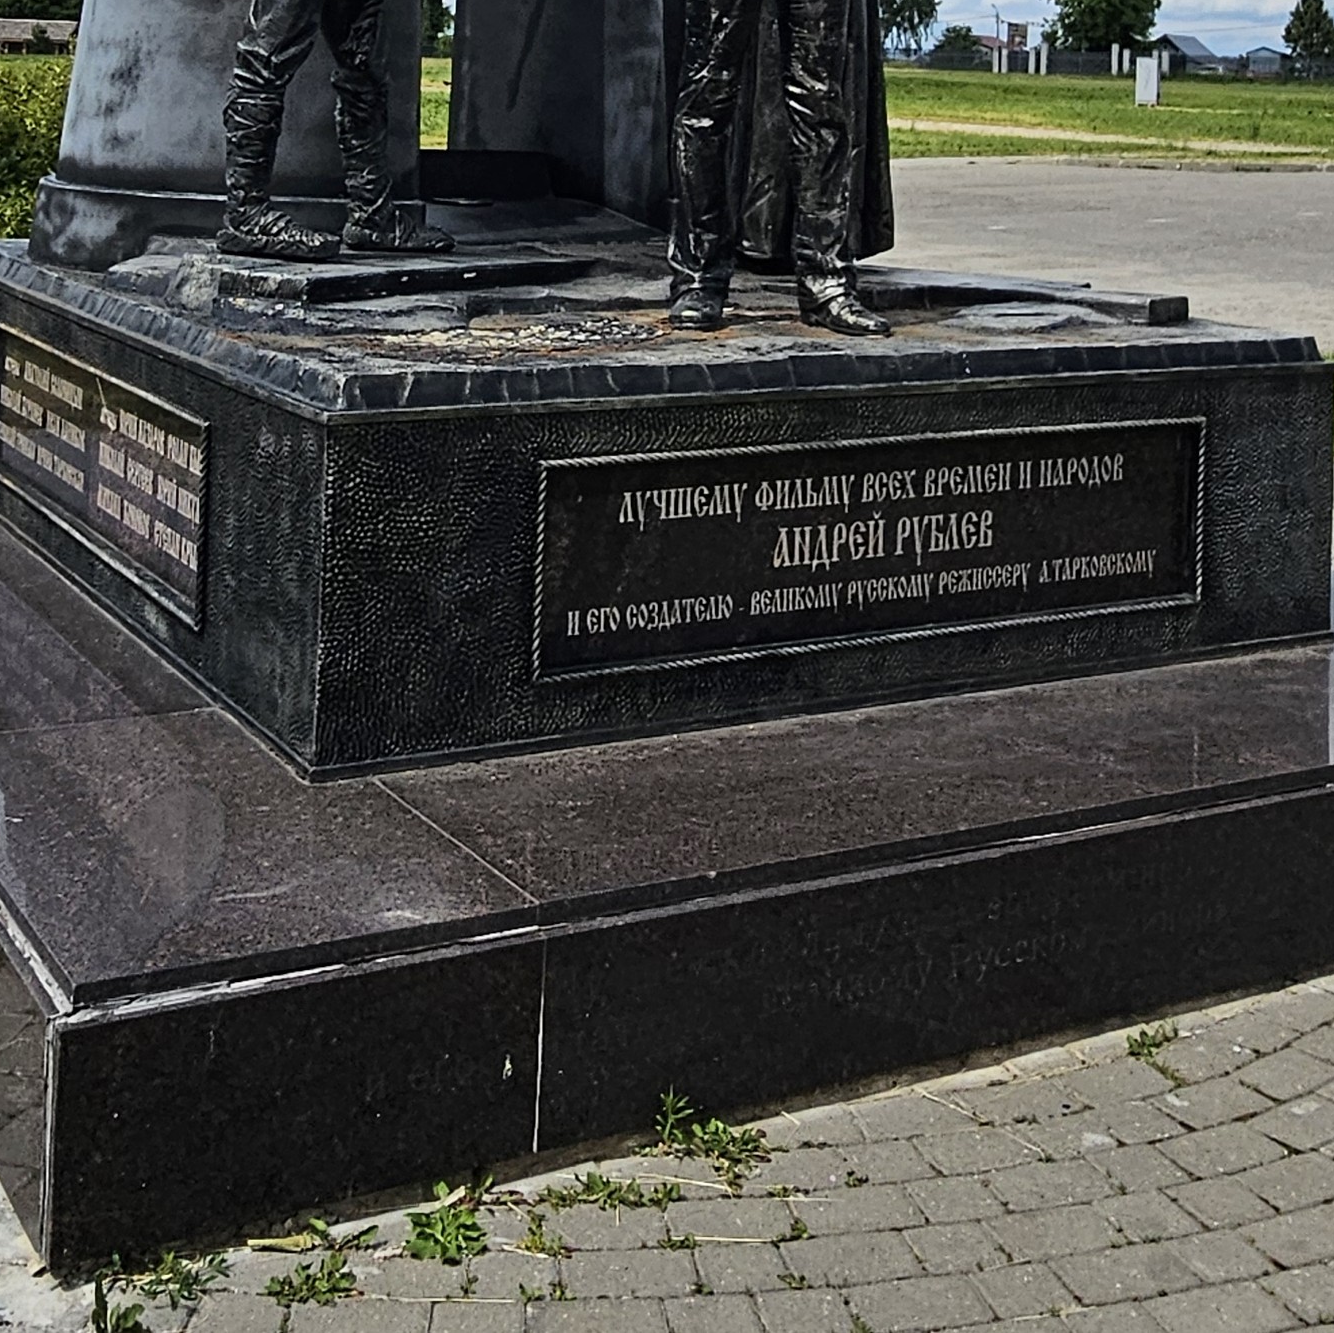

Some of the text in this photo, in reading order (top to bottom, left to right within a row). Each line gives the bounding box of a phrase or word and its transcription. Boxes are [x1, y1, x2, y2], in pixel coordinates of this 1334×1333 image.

[619, 454, 1123, 531] ЛУЧШЕМУ ФИЛЬМУ ВСЕХ ВРЕМЕН И НАРОДОВ
[773, 508, 992, 572] АНДРЕЙ РУБЛЕВ
[568, 611, 579, 635] И
[587, 607, 620, 633] ЕГО
[627, 595, 732, 630] СОЗДАТЕЛЮ
[750, 583, 842, 615] ВЕЛИКОМУ
[848, 573, 933, 610] РУССКОМУ
[939, 563, 1030, 594] РЕЖИССЕРУ
